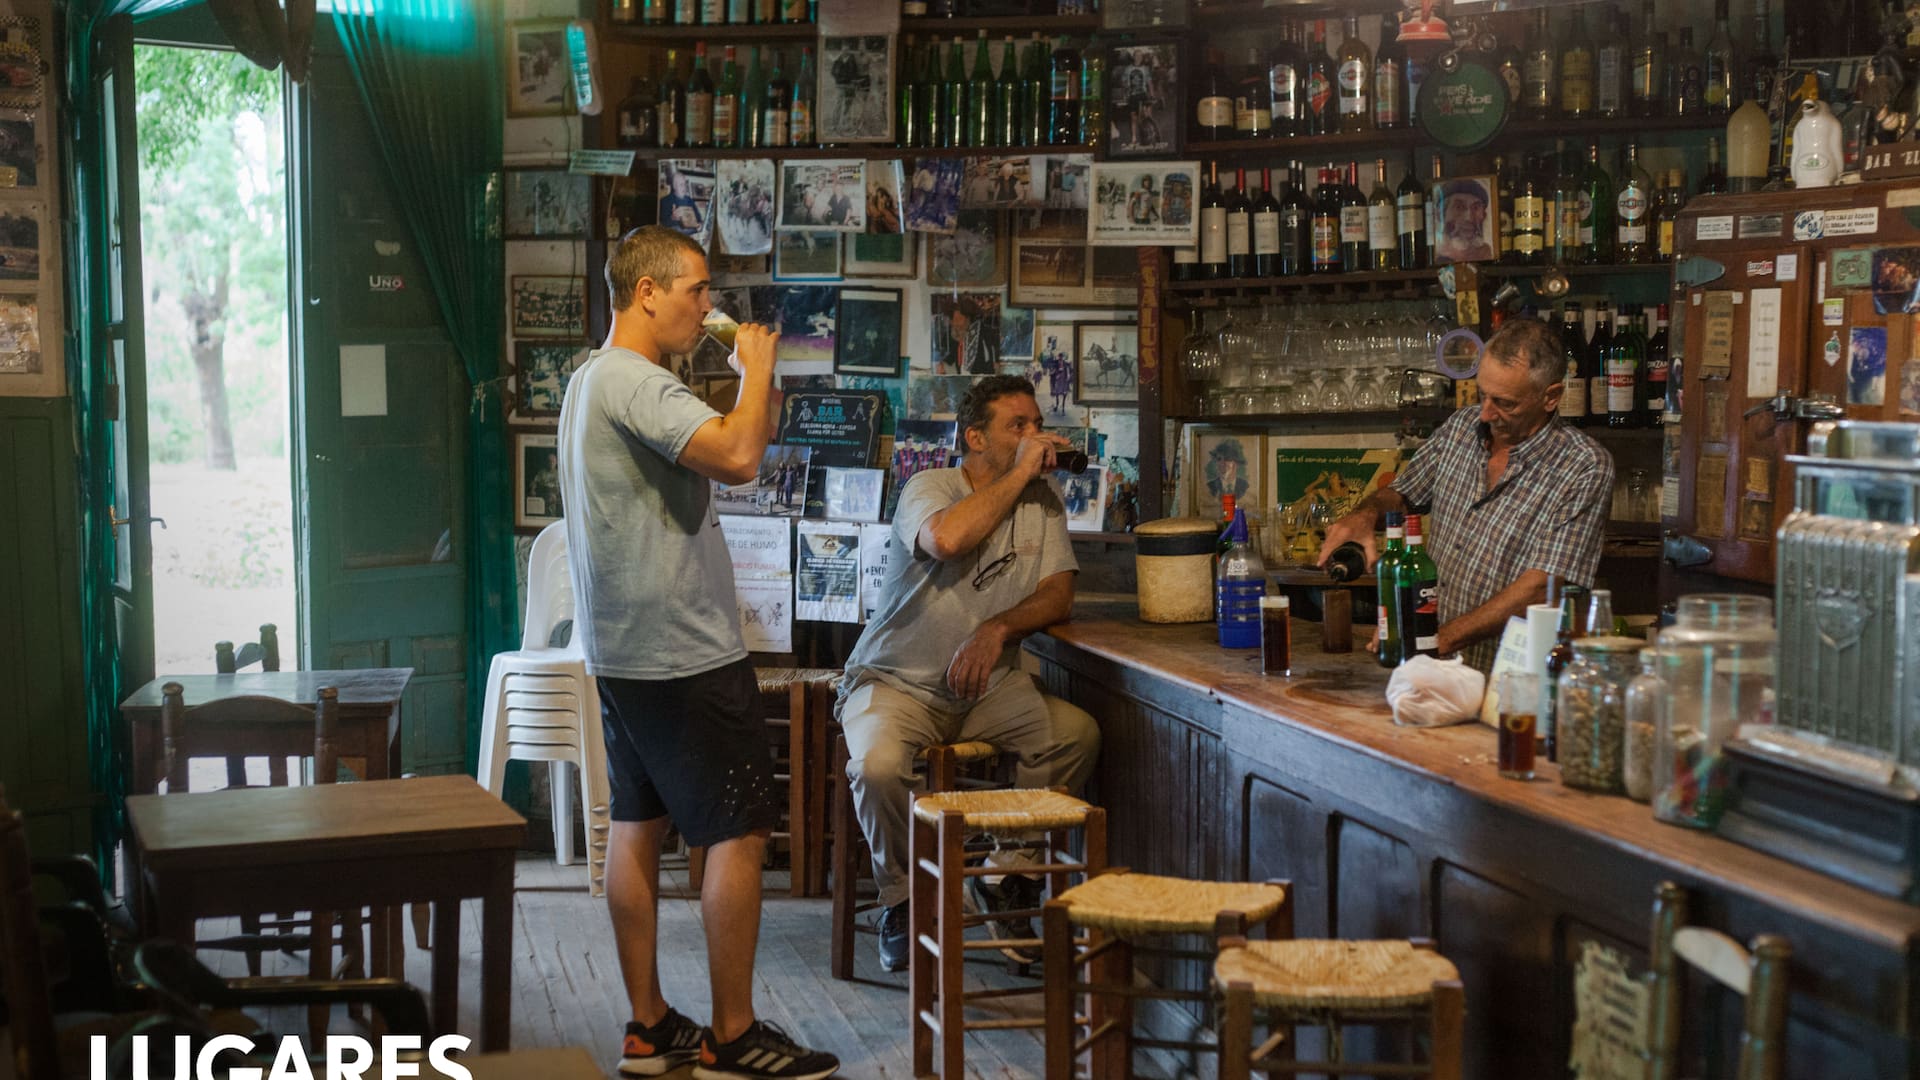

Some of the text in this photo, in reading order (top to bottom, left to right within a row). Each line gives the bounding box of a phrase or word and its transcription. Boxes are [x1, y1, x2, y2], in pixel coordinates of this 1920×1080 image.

[1865, 153, 1891, 170] BAR
[1516, 210, 1540, 218] BOLS
[738, 540, 749, 549] DE
[750, 540, 777, 550] HUMO
